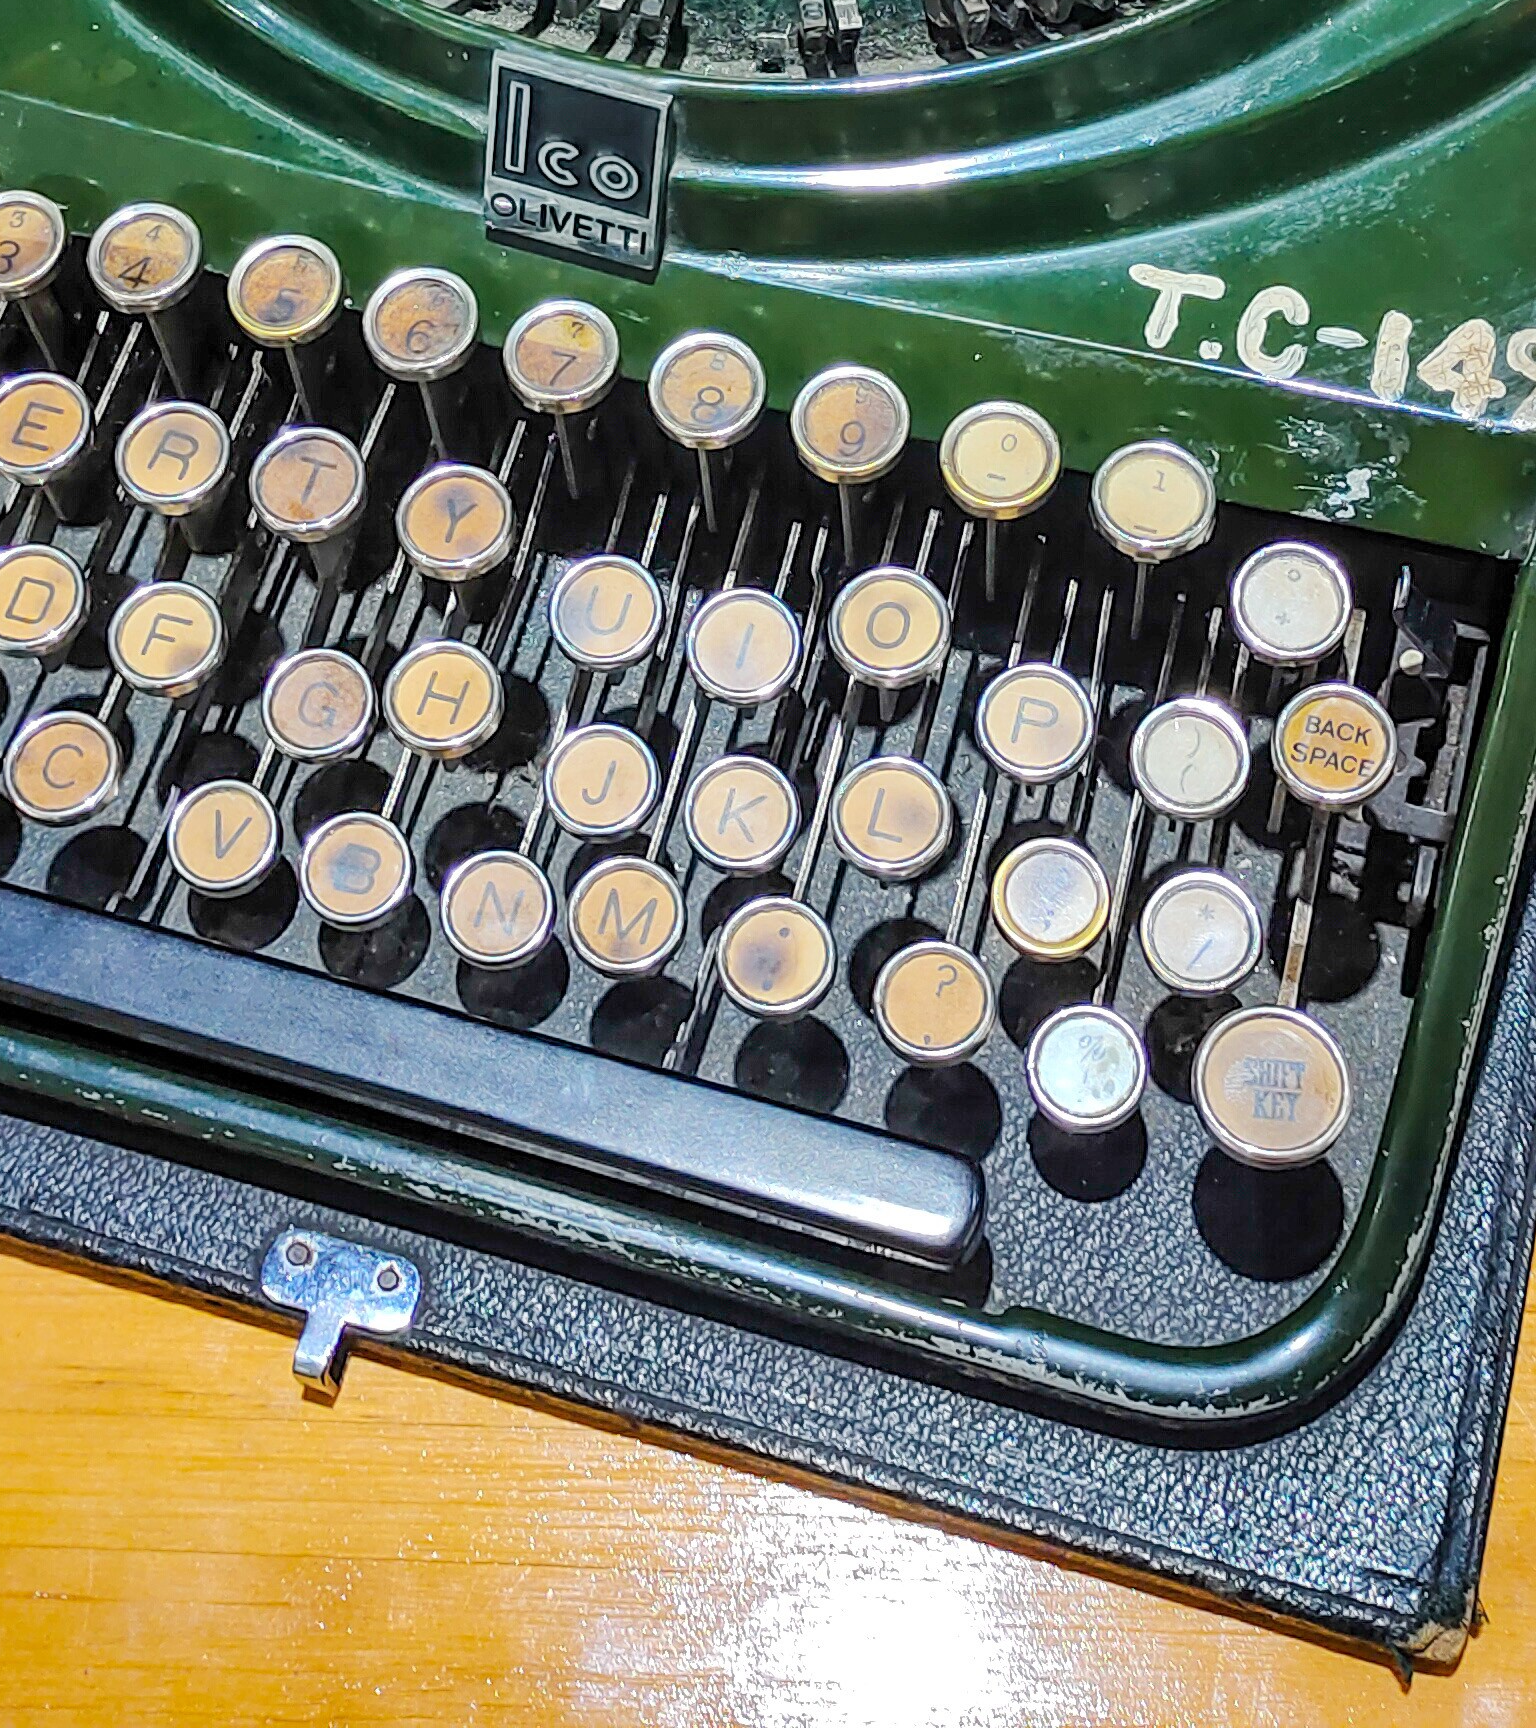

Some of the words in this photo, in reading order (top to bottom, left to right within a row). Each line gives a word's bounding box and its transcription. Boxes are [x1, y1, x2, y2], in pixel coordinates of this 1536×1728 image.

[505, 80, 639, 200] Ico
[10, 210, 26, 228] 3
[491, 193, 647, 255] OLIVETTI
[117, 257, 152, 290] 4
[258, 287, 303, 323] 5
[406, 319, 433, 353] 6
[549, 350, 579, 387] 7
[12, 401, 65, 452] E
[690, 385, 724, 424] 8
[147, 429, 201, 481] R
[838, 420, 866, 457] 9
[301, 456, 338, 505] T
[444, 497, 478, 544] Y
[5, 575, 56, 625] D
[583, 584, 633, 637] U
[140, 612, 194, 656] F
[298, 680, 339, 729] G
[417, 670, 470, 725] H
[1010, 695, 1059, 744] P
[1303, 714, 1372, 747] BACK
[42, 743, 84, 789] C
[580, 759, 617, 806] J
[1290, 742, 1376, 777] SPACE
[215, 809, 253, 860] V
[717, 787, 769, 843] K
[866, 787, 903, 843] L
[329, 842, 382, 895] B
[473, 880, 526, 936] N
[597, 887, 659, 945] M
[1244, 1056, 1307, 1089] SHIFT
[1251, 1088, 1302, 1122] KEY
